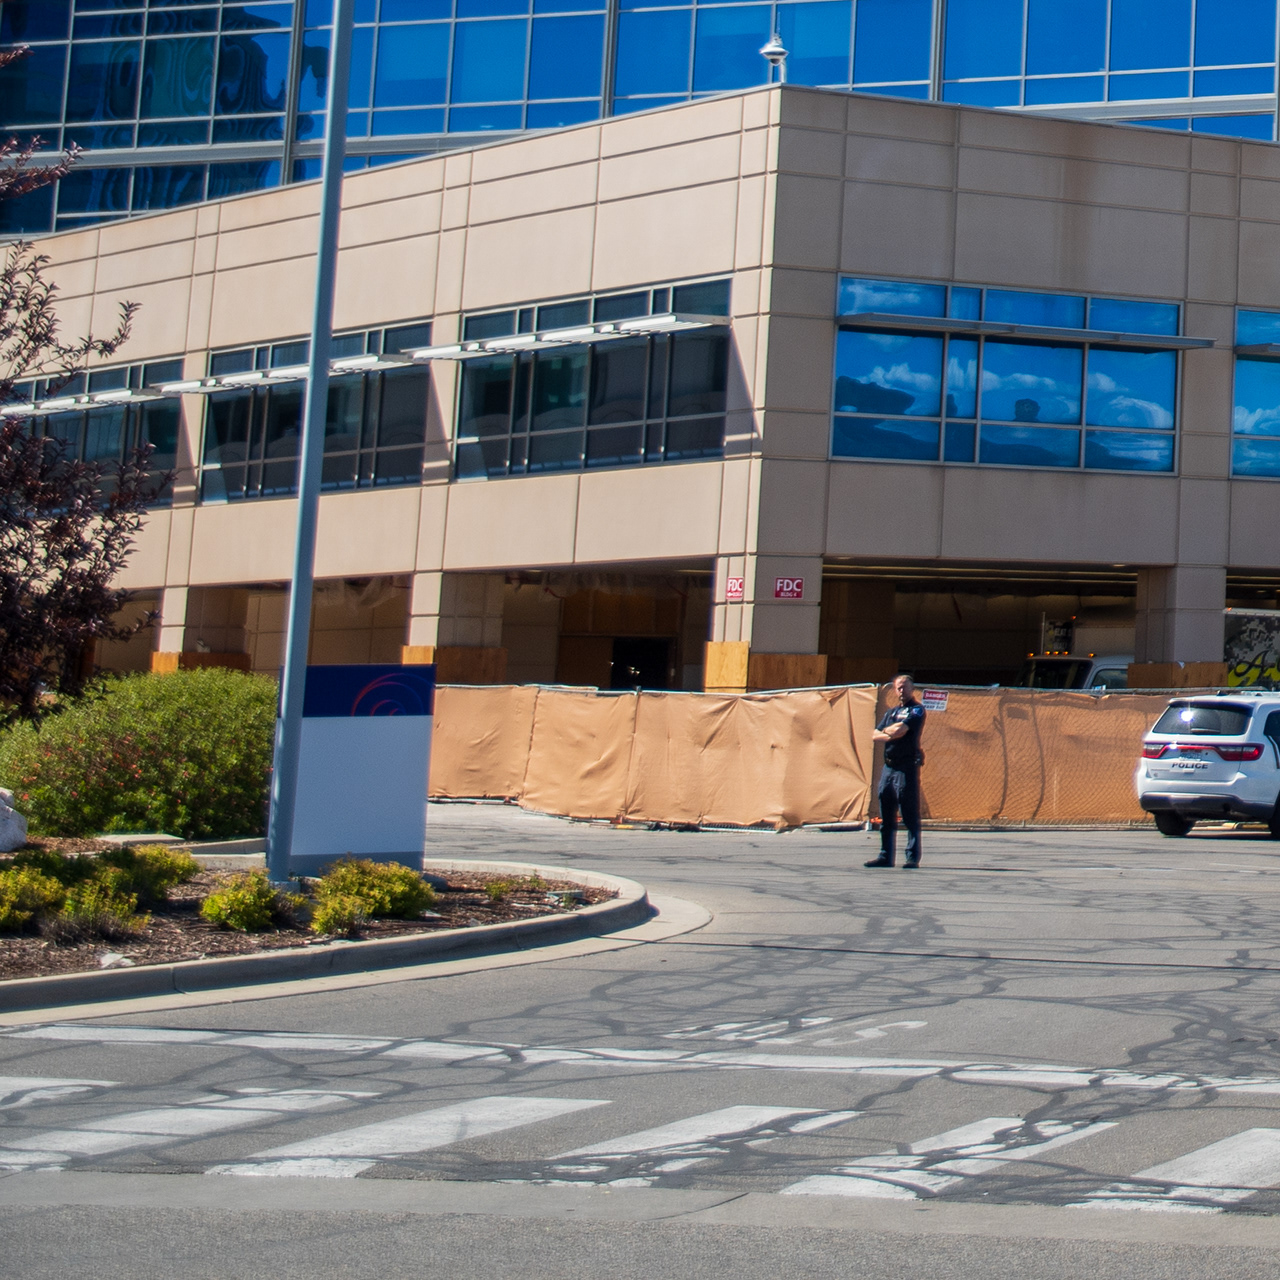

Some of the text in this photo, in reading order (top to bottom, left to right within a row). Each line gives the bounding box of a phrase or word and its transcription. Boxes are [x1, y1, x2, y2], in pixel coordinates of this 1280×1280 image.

[727, 579, 744, 591] FDC
[776, 579, 803, 592] FDC
[1172, 762, 1209, 770] POLICE
